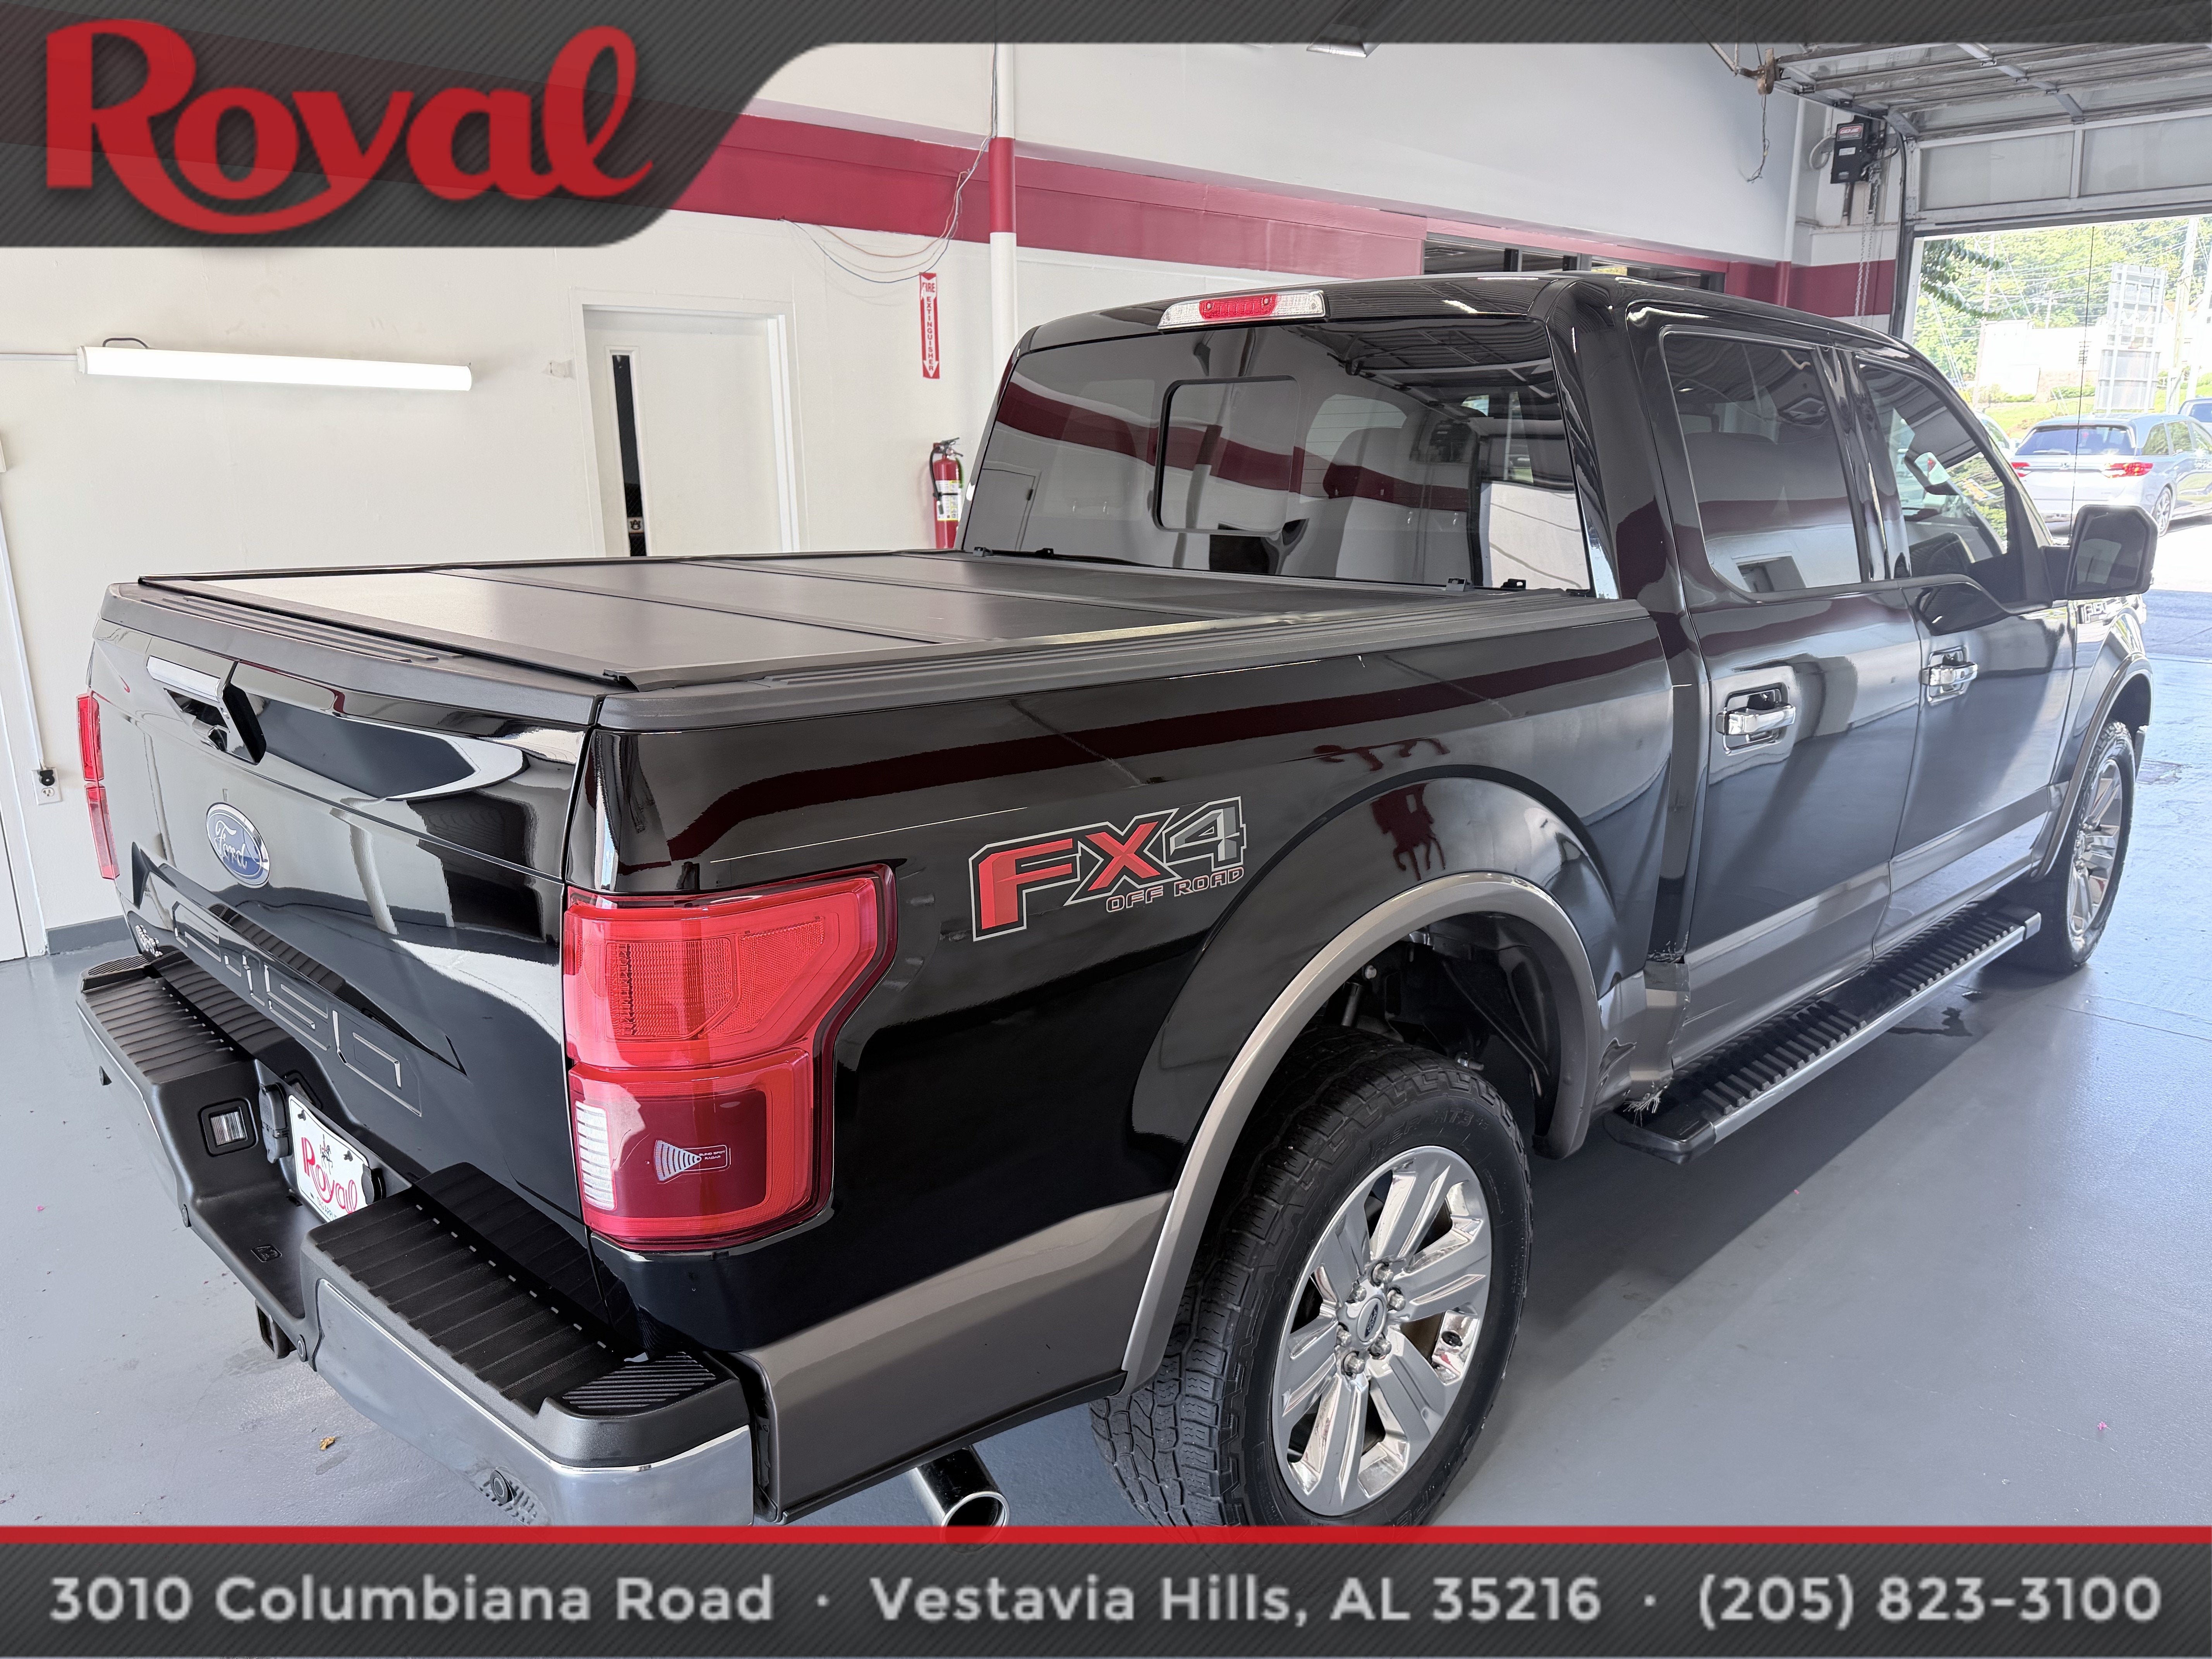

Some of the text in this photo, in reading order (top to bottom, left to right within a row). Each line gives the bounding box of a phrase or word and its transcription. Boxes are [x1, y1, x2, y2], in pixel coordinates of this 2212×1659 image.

[922, 282, 935, 293] FIRE
[214, 820, 247, 870] Ford
[969, 797, 1246, 941] FX4
[1106, 867, 1244, 913] OFF ROAD
[172, 901, 422, 1117] F-150
[301, 1137, 357, 1214] Royal
[1367, 1309, 1377, 1333] Ford
